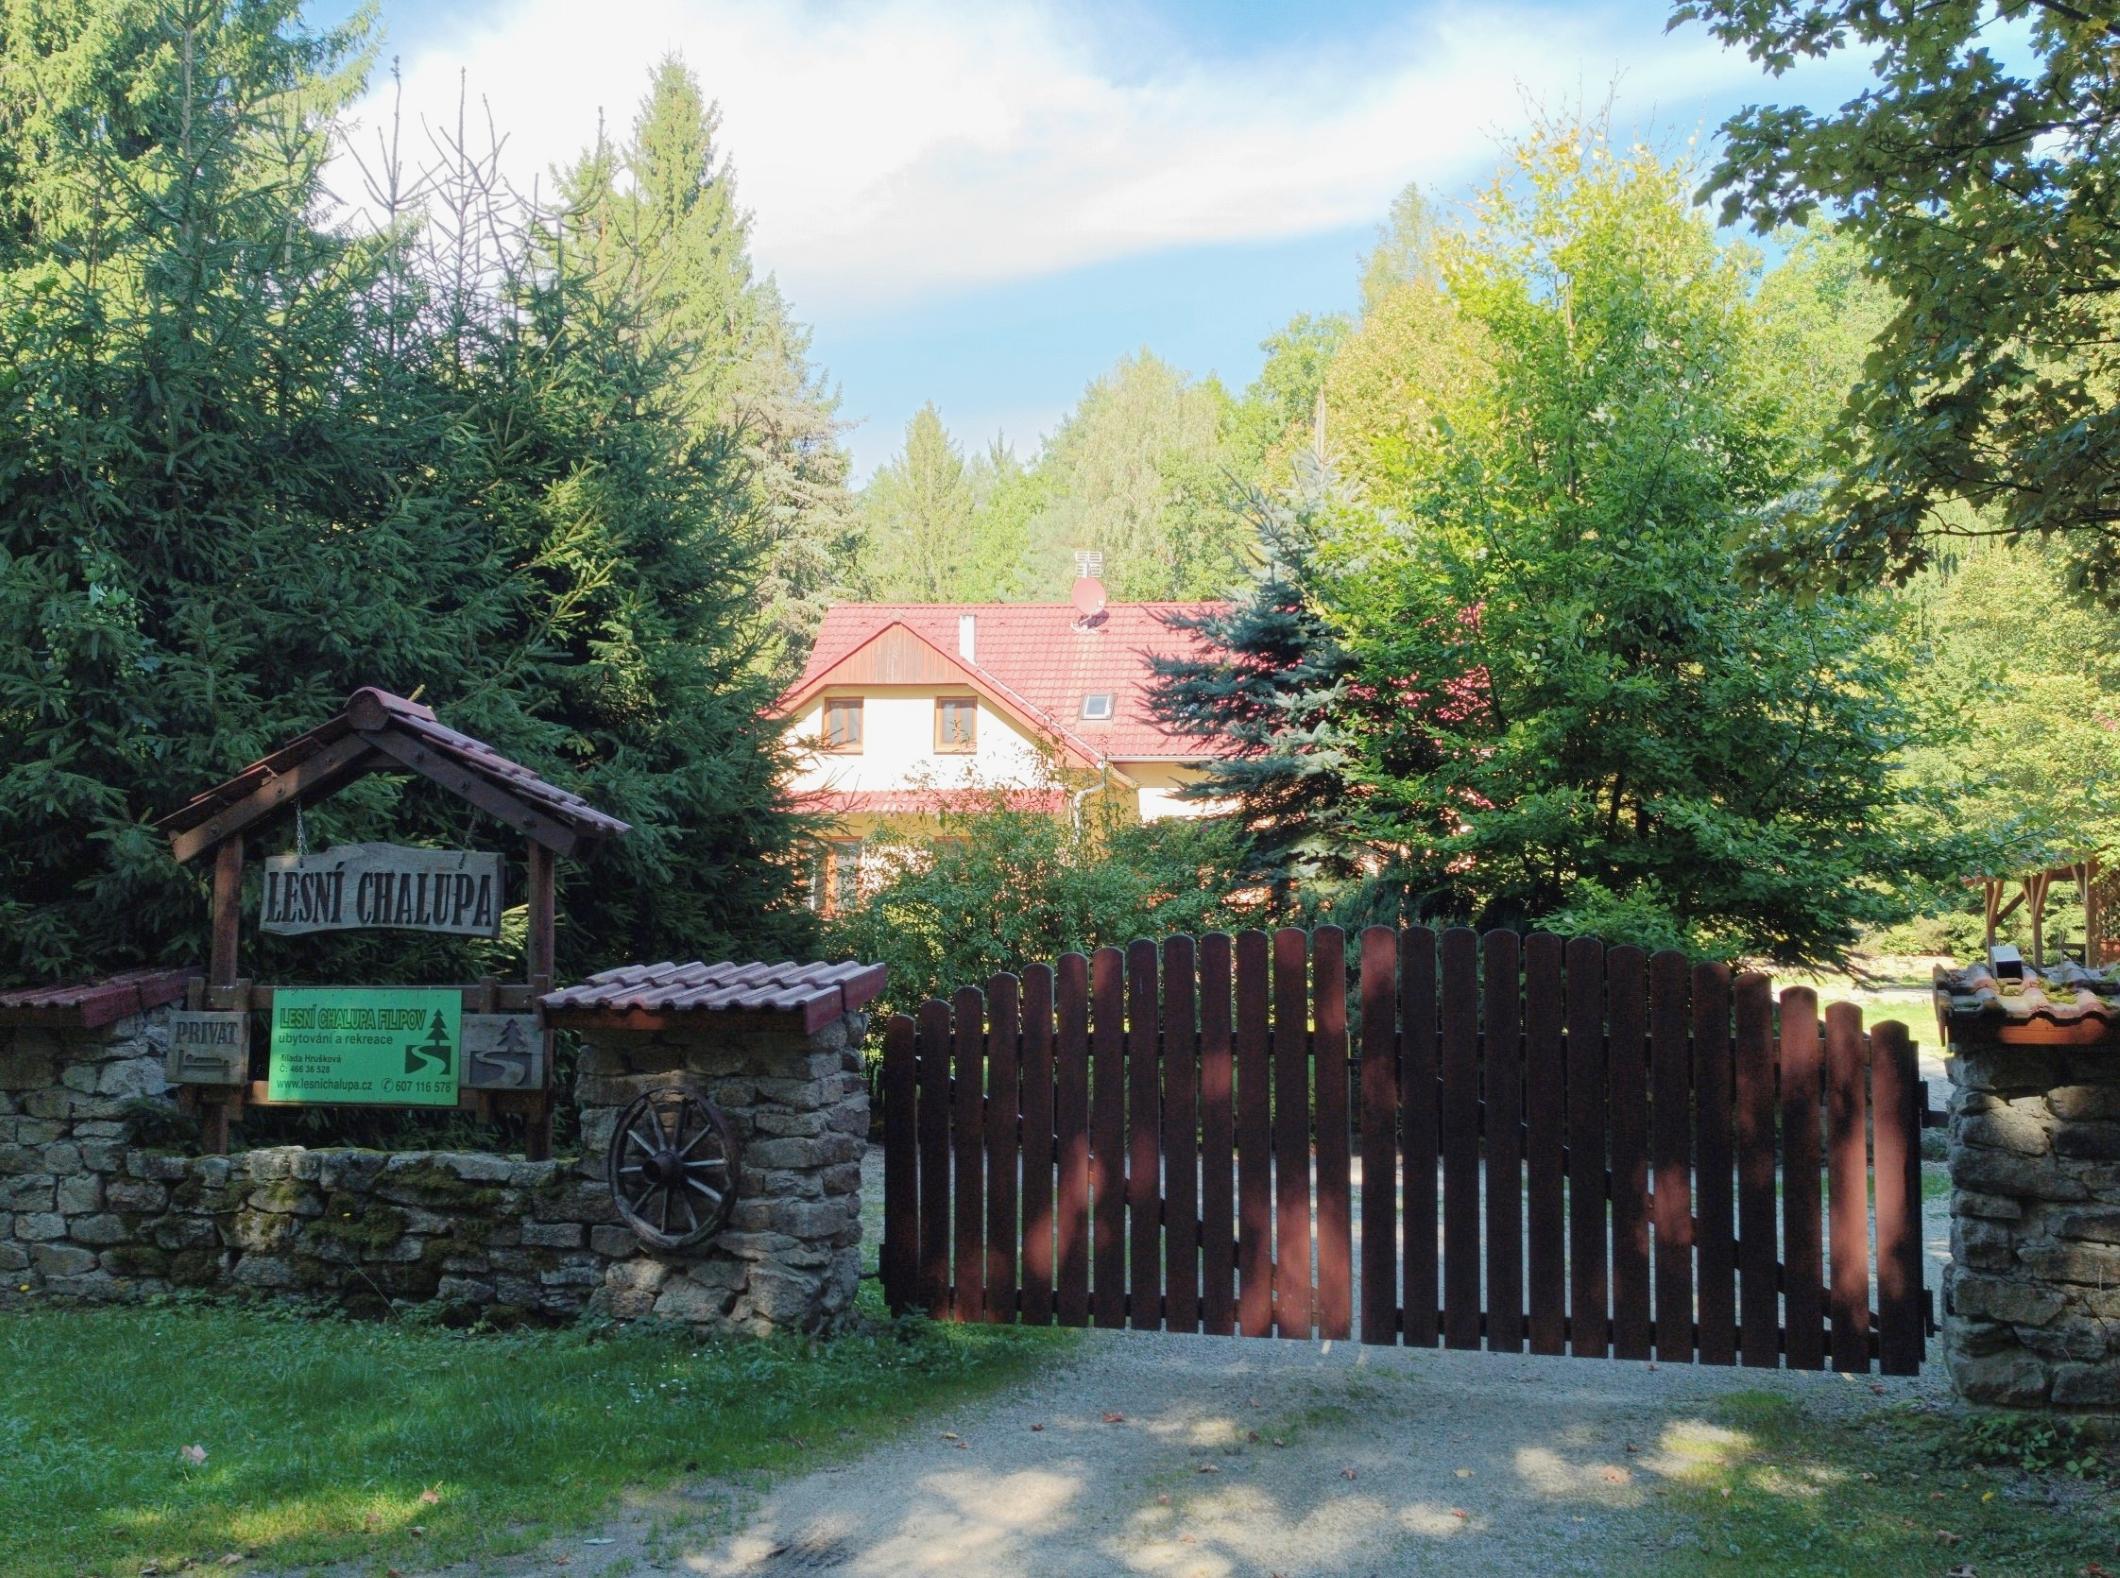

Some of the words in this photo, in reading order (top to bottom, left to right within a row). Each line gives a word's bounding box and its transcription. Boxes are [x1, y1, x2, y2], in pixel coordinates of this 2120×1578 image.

[265, 861, 345, 923] LESNÍ
[357, 871, 493, 927] CHALUPA
[280, 1004, 317, 1029] LESNÍ
[318, 1008, 376, 1030] CHALUPA
[378, 1008, 427, 1031] FILIPOV
[175, 1021, 239, 1045] PRIVAT
[278, 1032, 332, 1046] ubytování
[336, 1036, 343, 1044] a
[345, 1033, 393, 1045] rekreace
[395, 1081, 413, 1092] 607
[416, 1081, 431, 1093] 116
